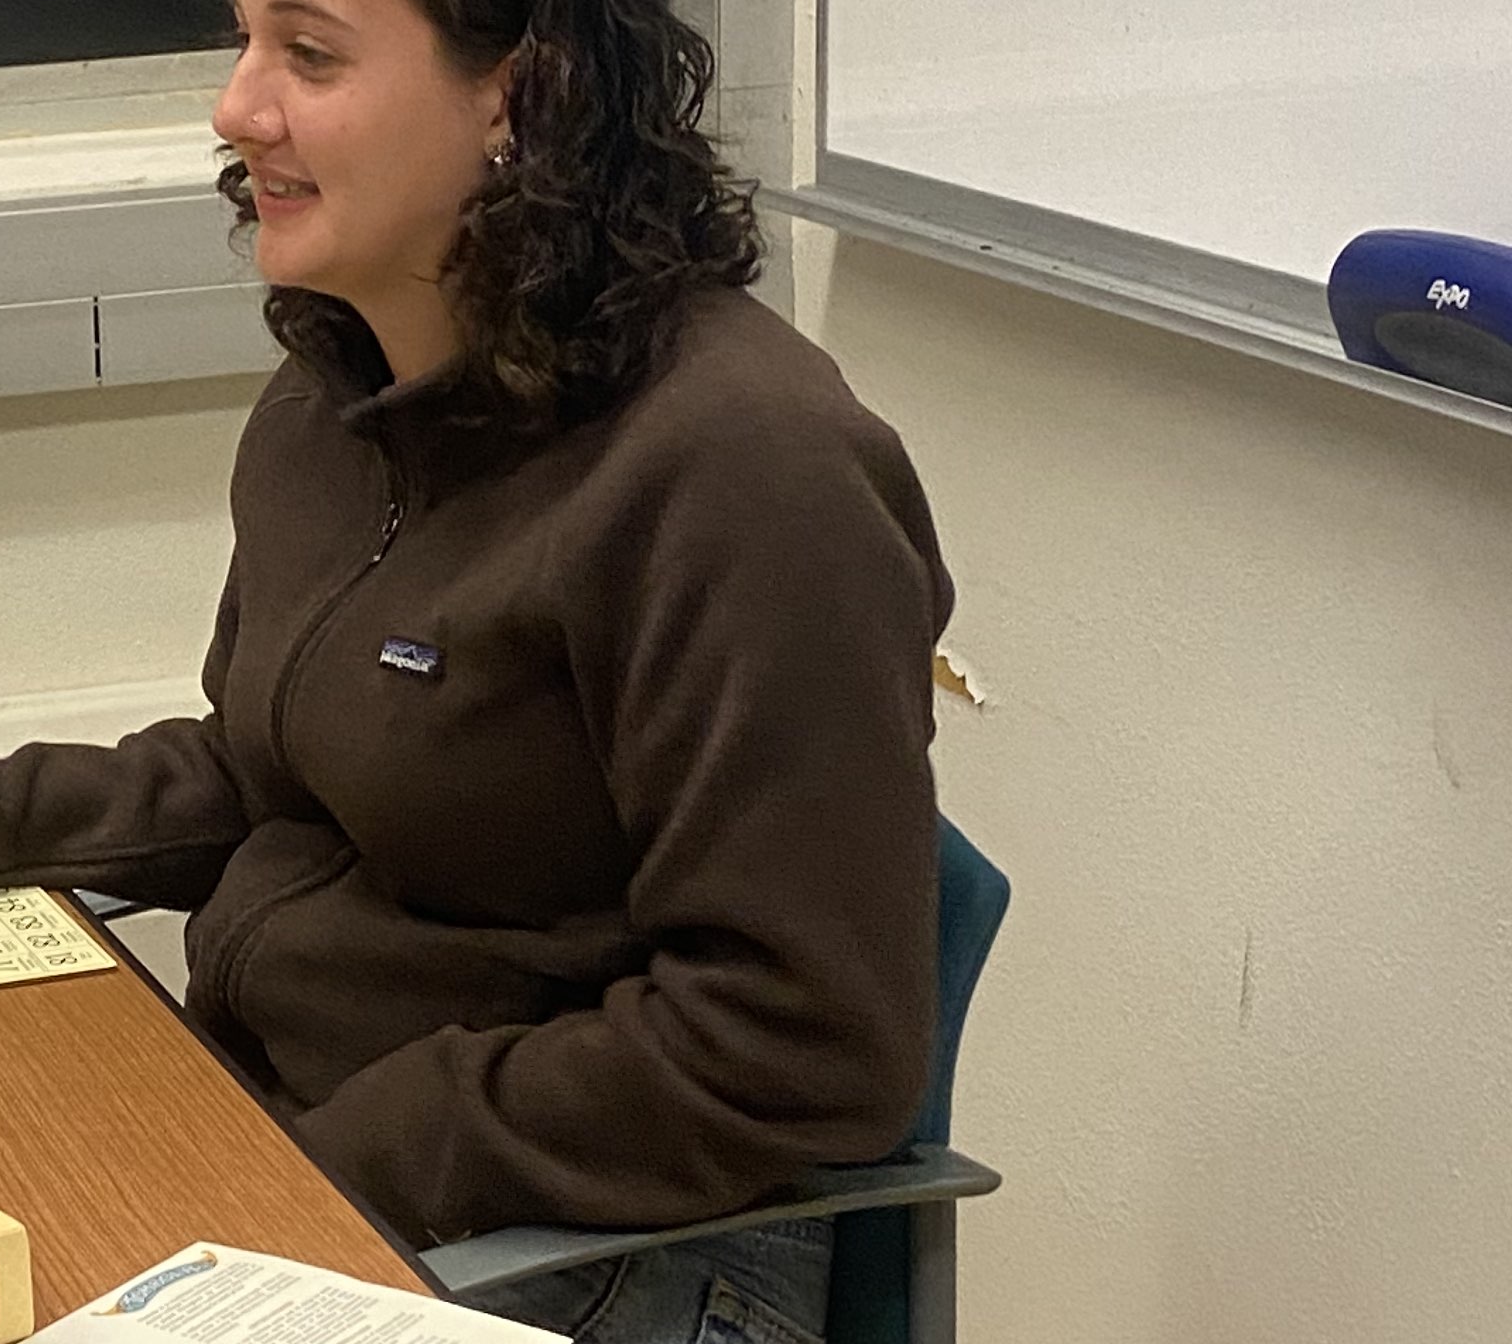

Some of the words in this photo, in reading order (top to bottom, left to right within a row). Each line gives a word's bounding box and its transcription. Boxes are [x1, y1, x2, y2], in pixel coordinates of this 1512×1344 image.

[10, 915, 43, 930] 83
[27, 933, 61, 948] 82
[46, 952, 78, 967] 81
